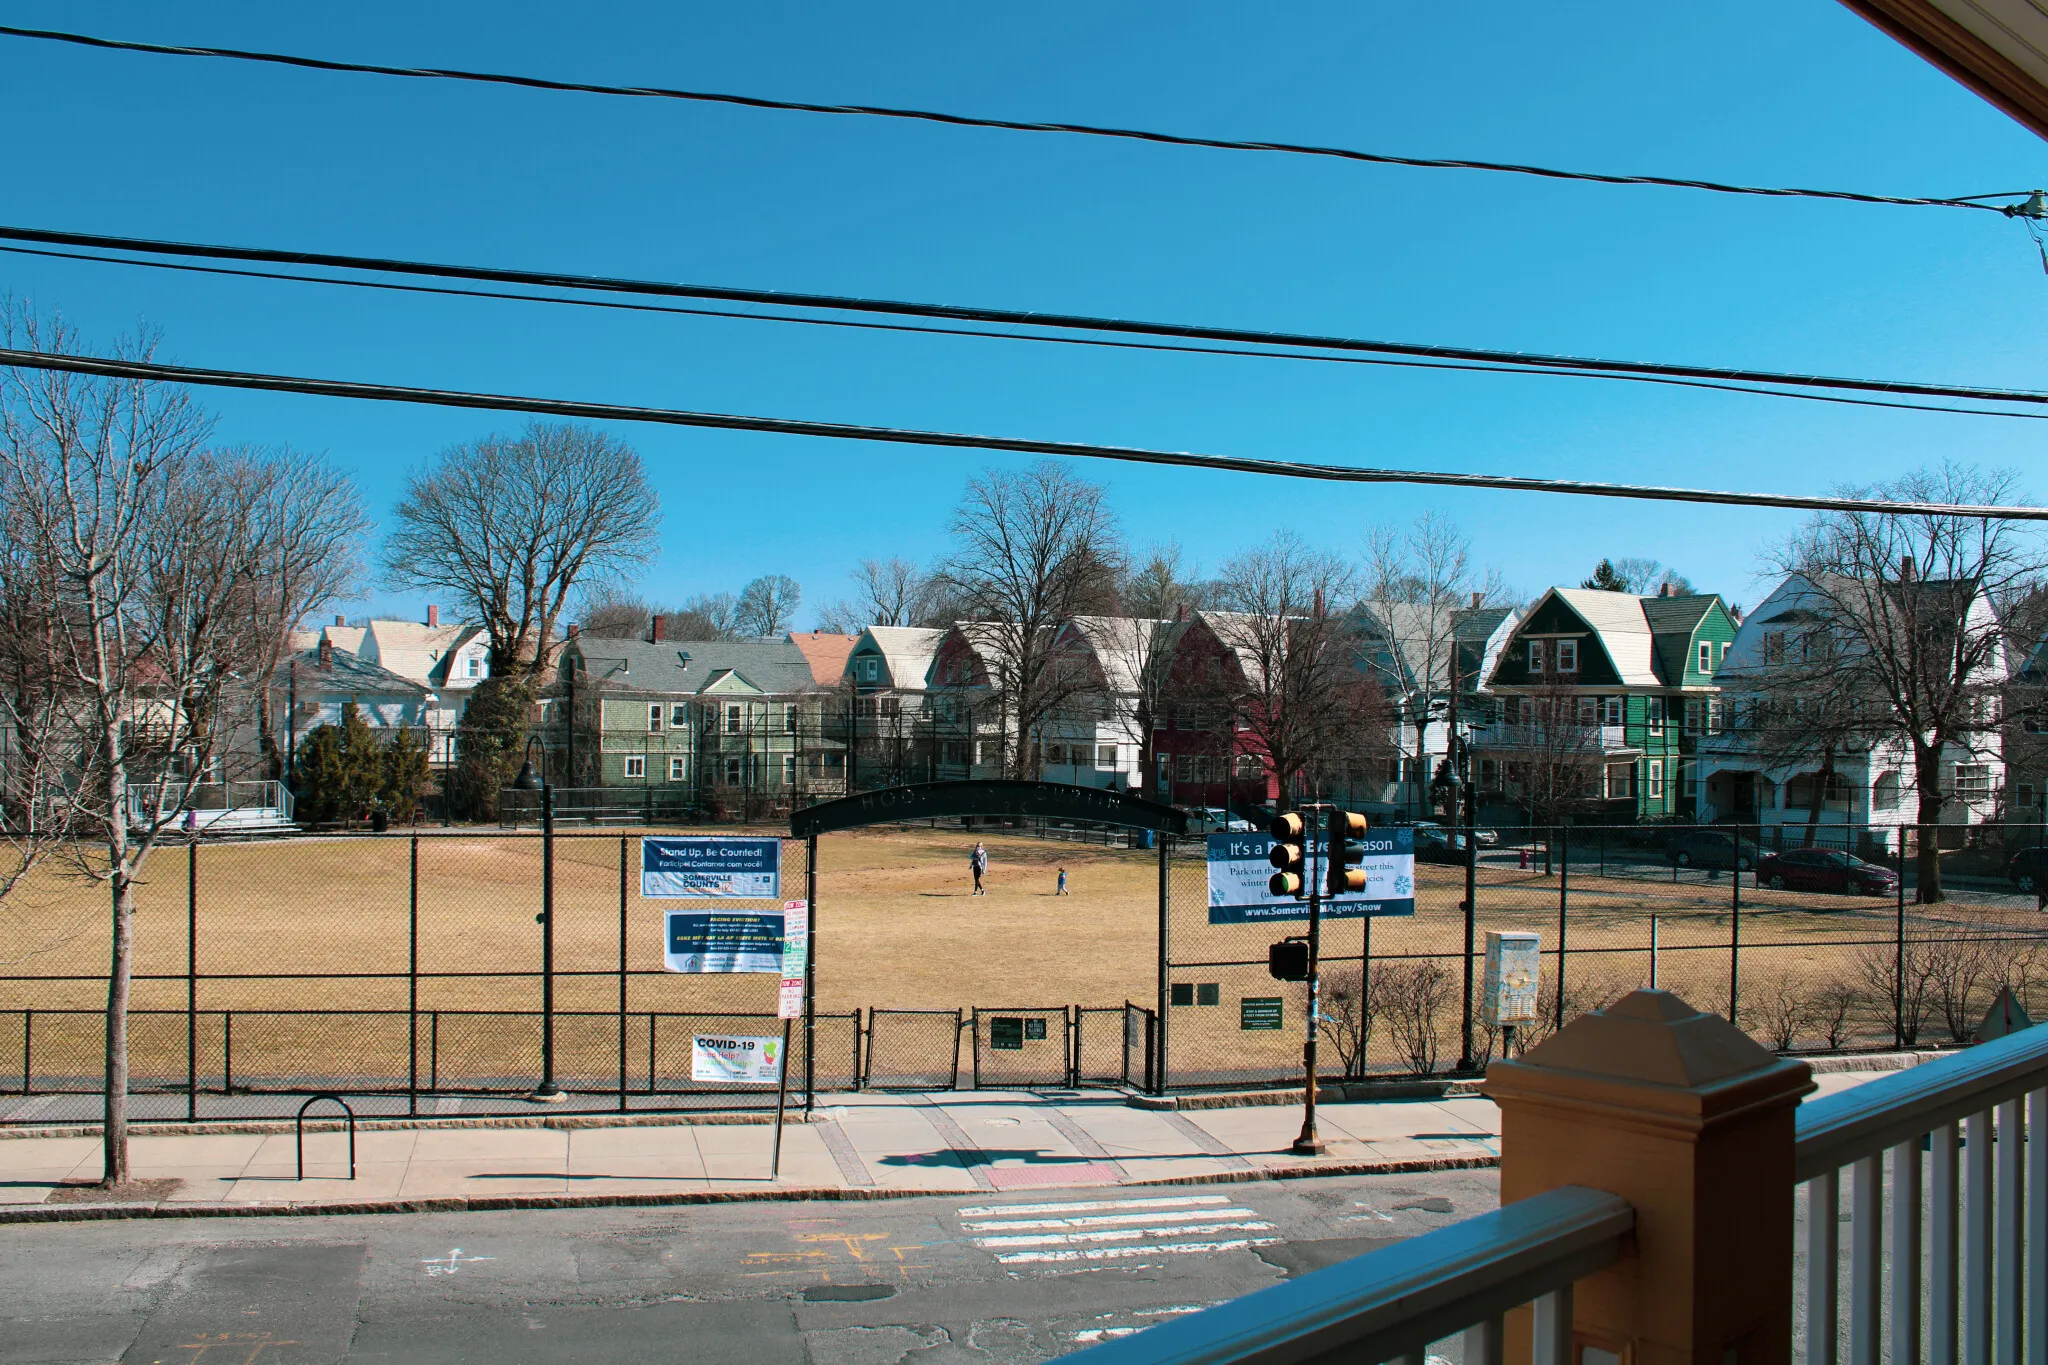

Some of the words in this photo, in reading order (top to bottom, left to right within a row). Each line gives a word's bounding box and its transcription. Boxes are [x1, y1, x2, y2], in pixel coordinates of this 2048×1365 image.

[660, 847, 687, 856] Stand
[689, 848, 704, 858] Up,
[706, 848, 718, 856] Be
[720, 848, 762, 857] Counted!
[1230, 842, 1250, 855] It's
[1254, 845, 1263, 854] a
[1230, 867, 1249, 876] Park
[1265, 866, 1278, 874] the
[1379, 862, 1394, 870] this
[1241, 879, 1268, 887] winter
[1245, 903, 1381, 916] www.SomerviMA.gov/Snow
[785, 942, 791, 951] 2
[697, 1038, 755, 1051] COVID-19
[718, 1052, 740, 1060] Help?
